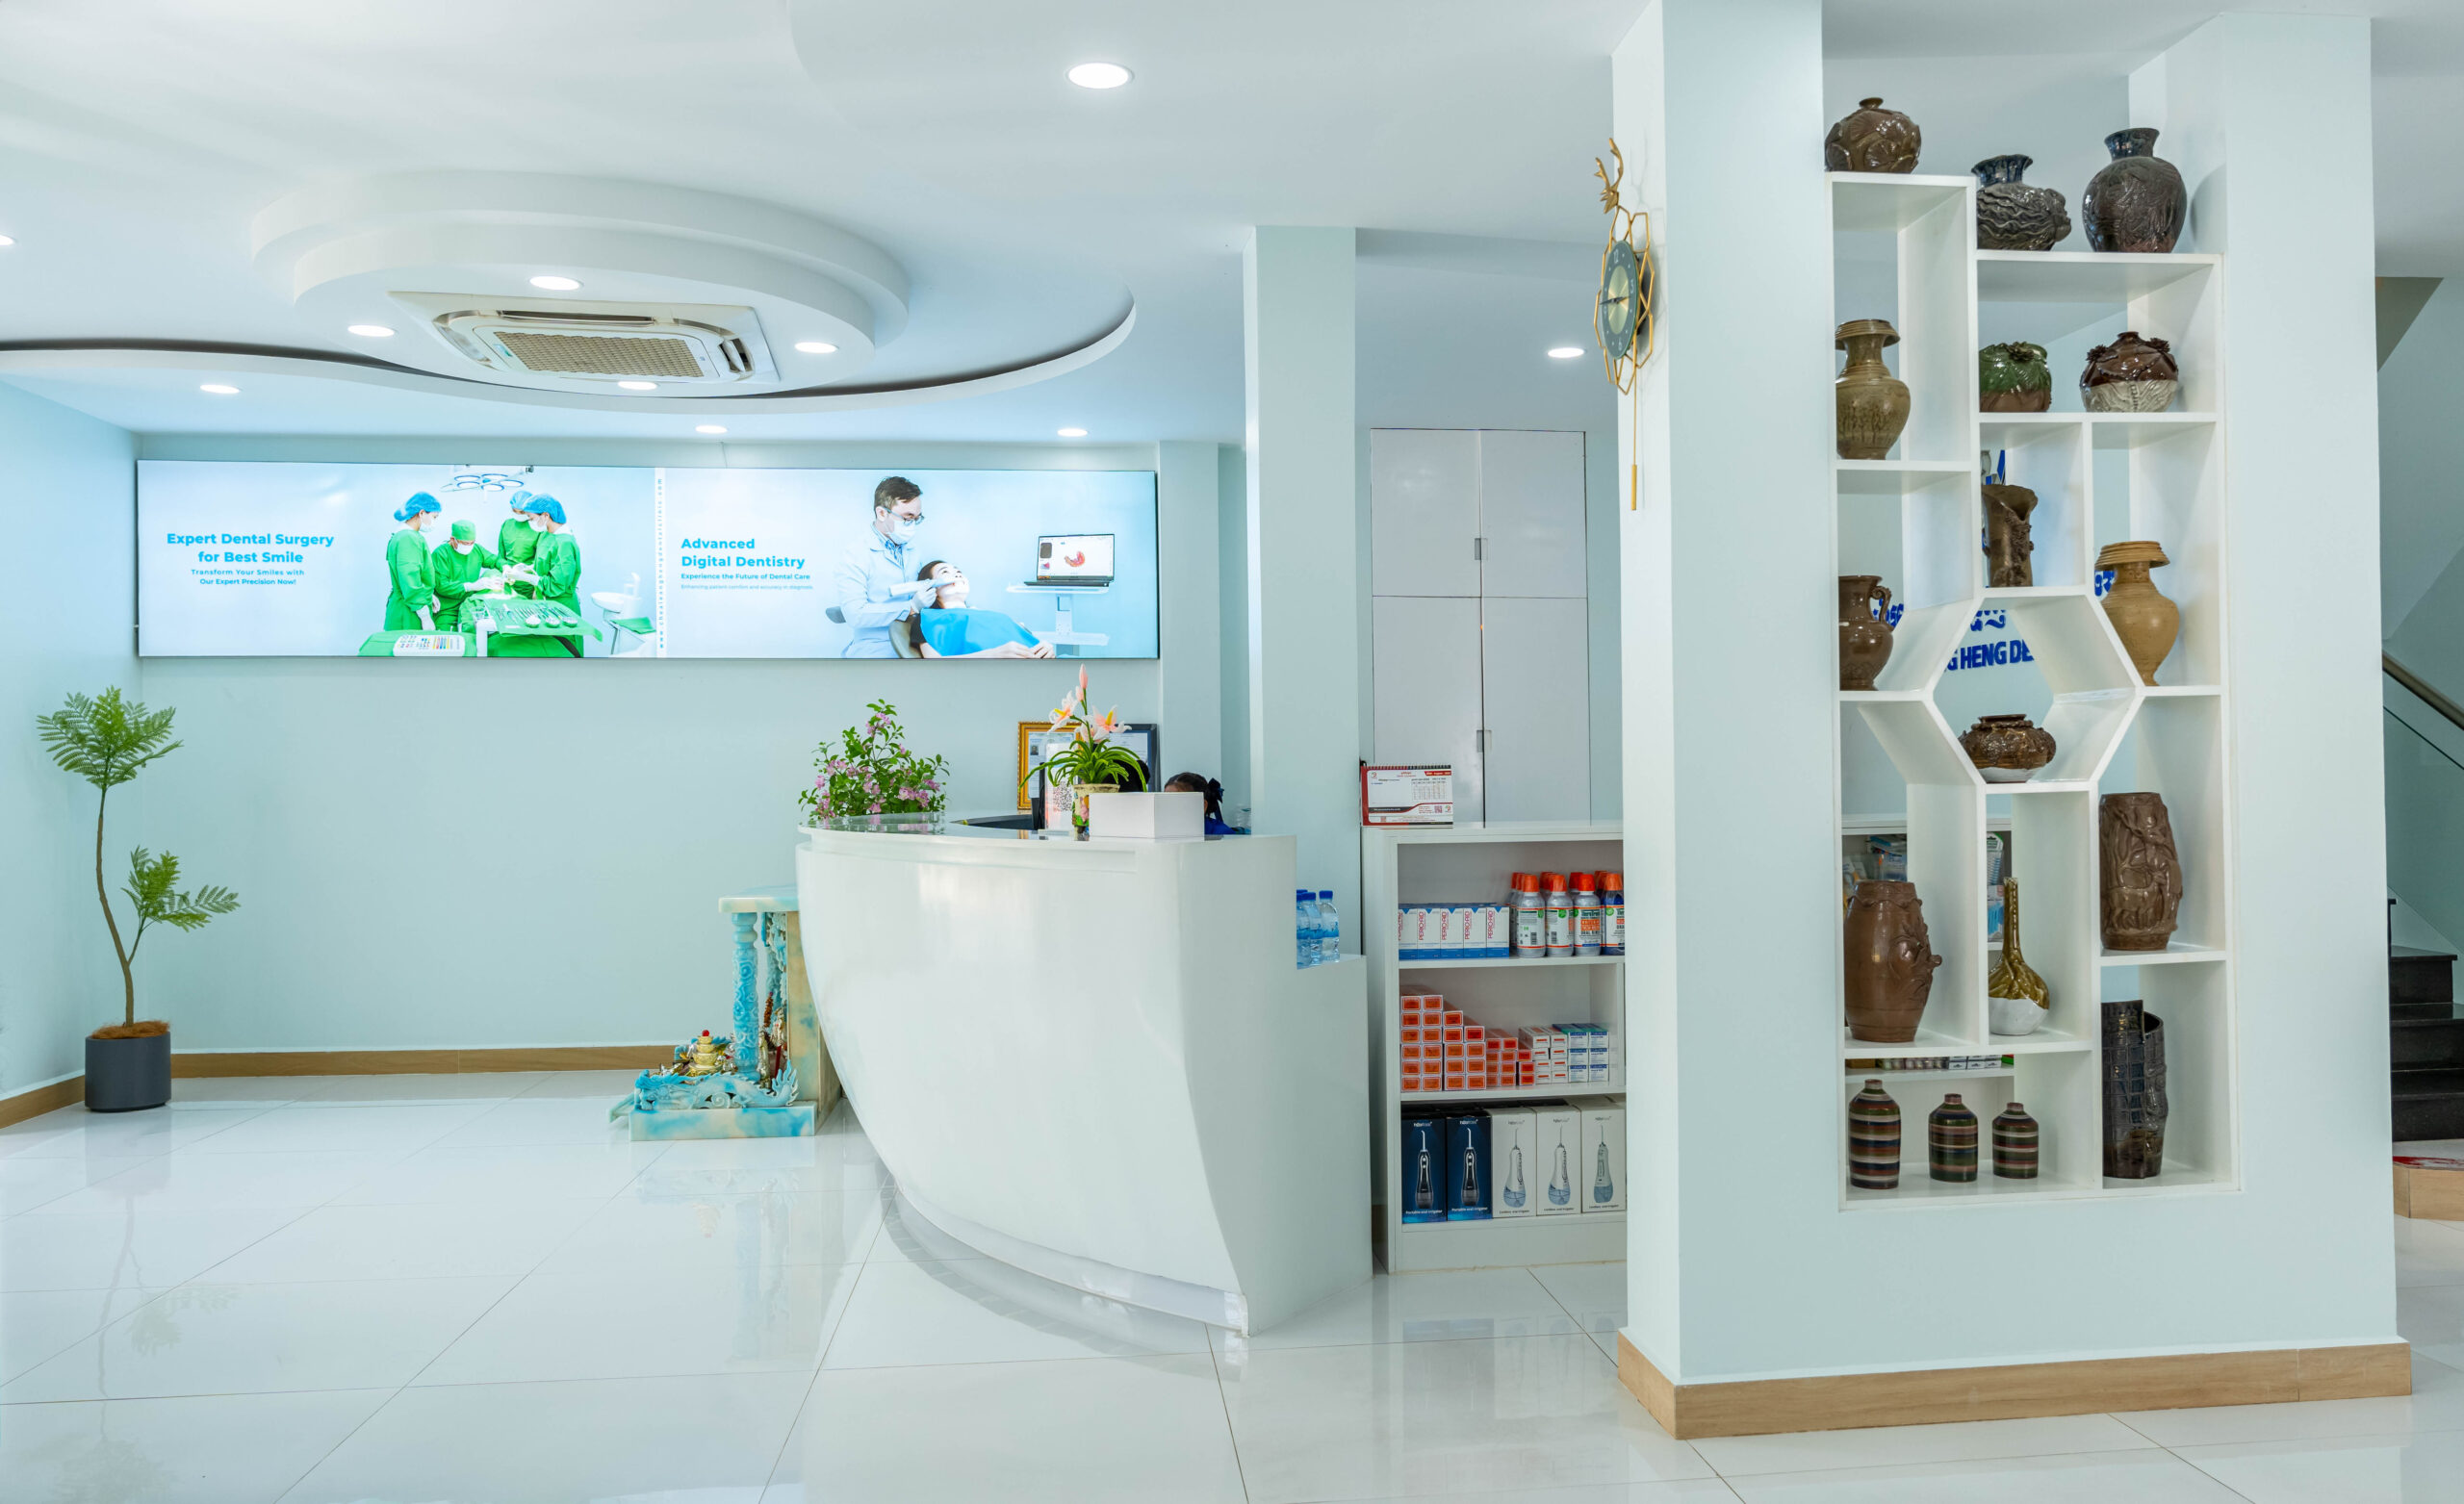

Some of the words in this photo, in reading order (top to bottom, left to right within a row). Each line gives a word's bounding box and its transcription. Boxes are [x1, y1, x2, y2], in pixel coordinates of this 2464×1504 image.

[167, 533, 217, 547] Expert
[221, 533, 270, 545] Dental
[275, 534, 334, 548] Surgery
[681, 538, 755, 548] Advanced
[198, 551, 219, 563] for
[224, 551, 257, 563] Best
[262, 551, 303, 563] Smile
[681, 555, 731, 569] Digital
[736, 555, 805, 569] Dentistry
[1960, 641, 2007, 670] HENG
